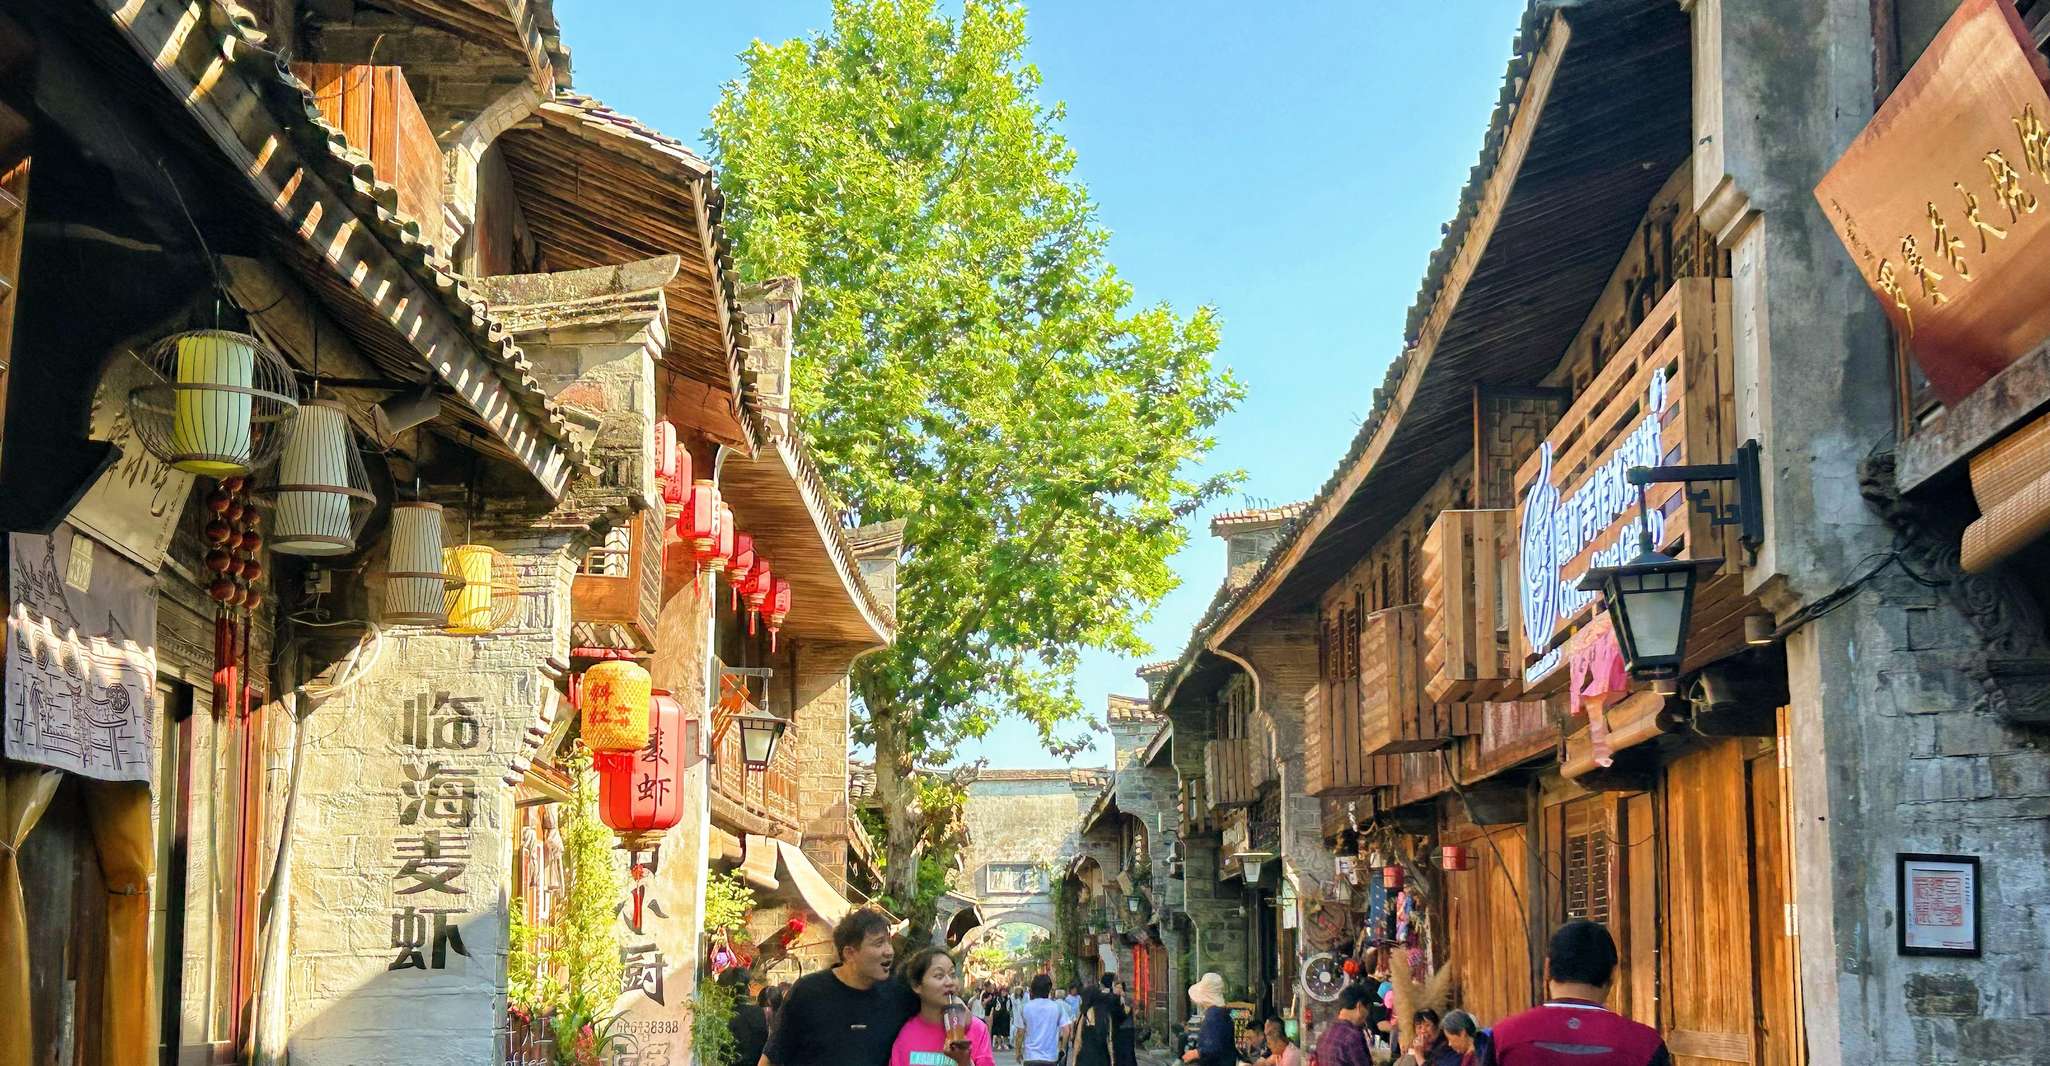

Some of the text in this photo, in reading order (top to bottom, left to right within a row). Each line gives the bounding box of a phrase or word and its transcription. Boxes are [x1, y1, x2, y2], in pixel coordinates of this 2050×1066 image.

[388, 690, 485, 971] 临海麦虾
[636, 726, 672, 807] 麦虾
